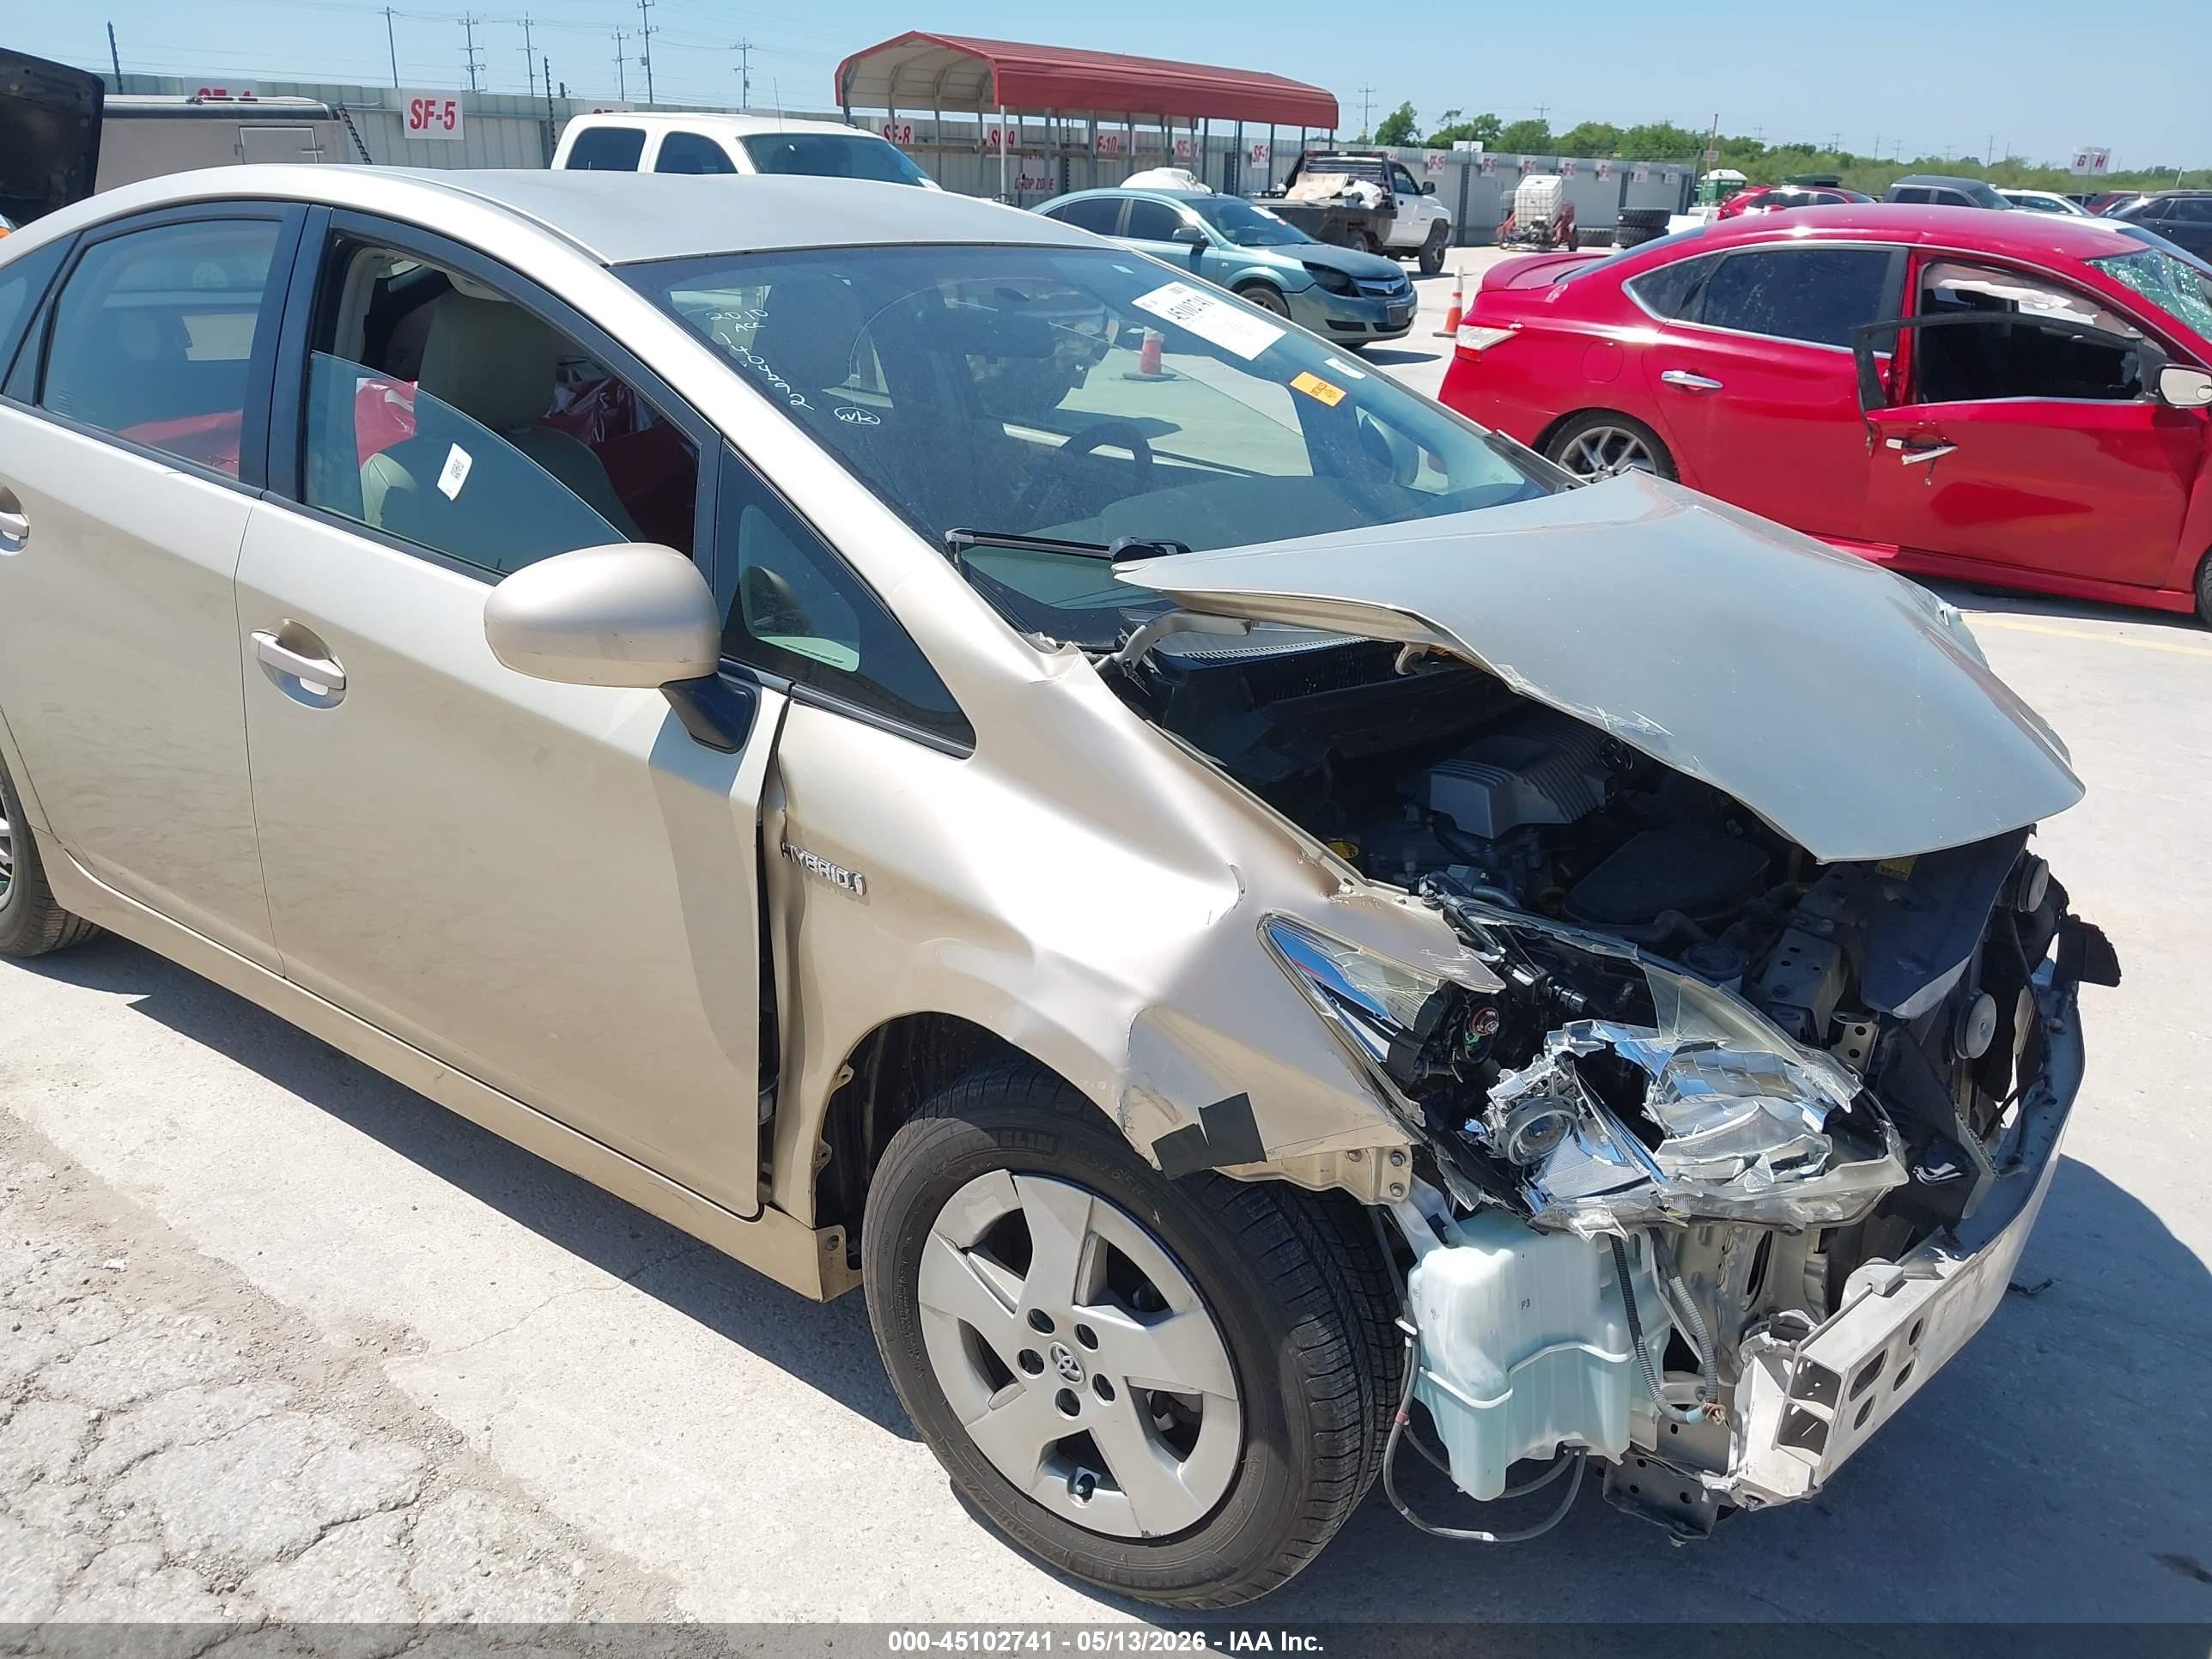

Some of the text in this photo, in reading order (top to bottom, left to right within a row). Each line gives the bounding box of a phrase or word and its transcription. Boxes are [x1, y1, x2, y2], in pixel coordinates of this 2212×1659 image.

[410, 99, 456, 131] SF-5
[2077, 155, 2087, 167] G
[2095, 155, 2106, 167] H
[1036, 178, 1054, 191] ZOE
[706, 308, 769, 320] 2010
[781, 841, 851, 890] HYBRID
